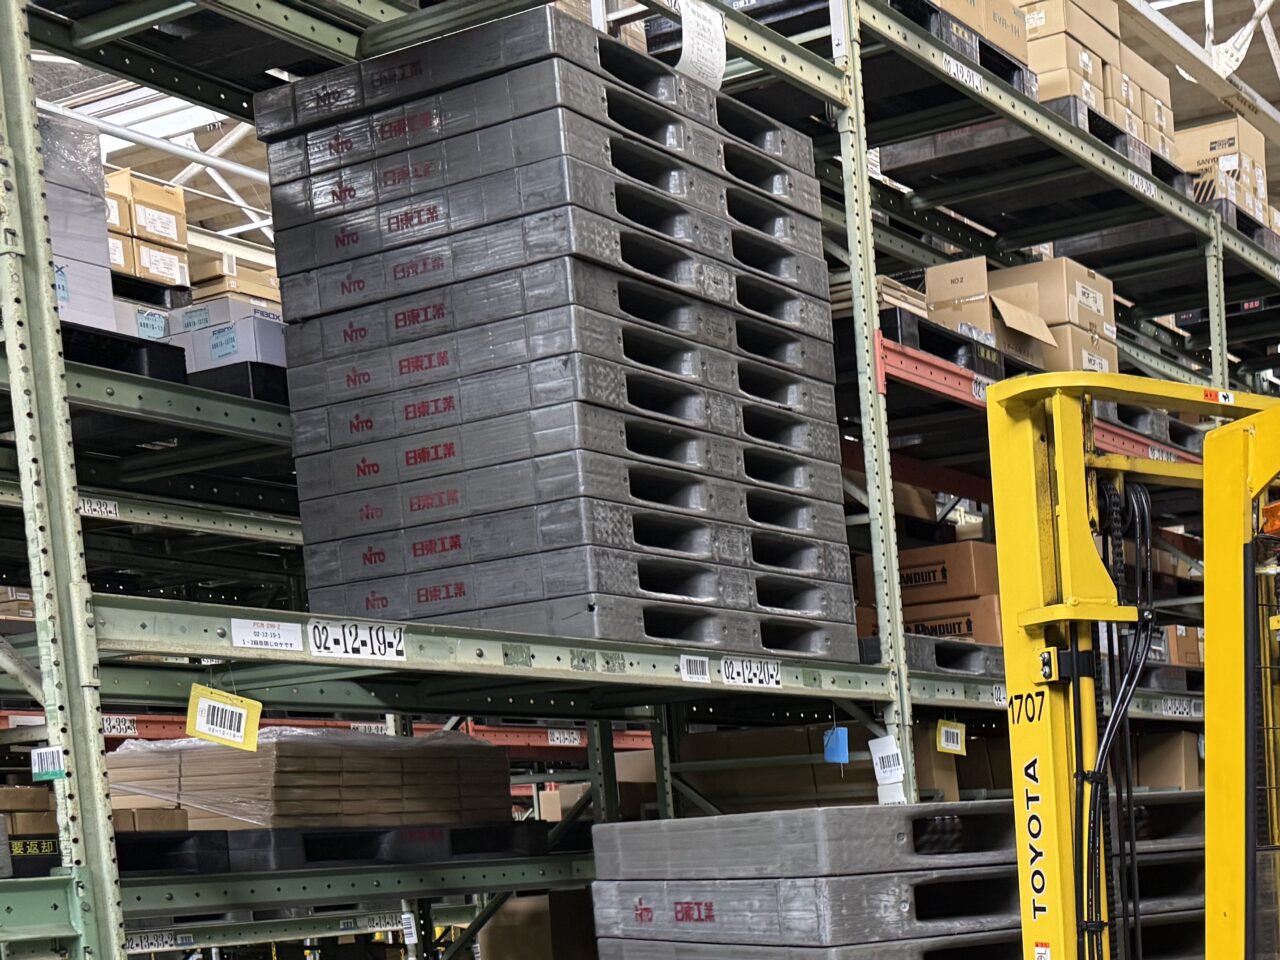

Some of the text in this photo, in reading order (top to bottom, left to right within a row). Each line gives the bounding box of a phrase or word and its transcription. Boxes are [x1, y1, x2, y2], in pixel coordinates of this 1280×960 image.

[404, 395, 455, 420] 日東工業
[405, 442, 456, 467] 日東工業
[312, 622, 405, 657] 02-12-19-2
[724, 659, 781, 686] 02-12-20-2
[1008, 691, 1045, 725] 1707
[11, 841, 53, 855] 要返却
[1023, 757, 1048, 920] TOYOTA
